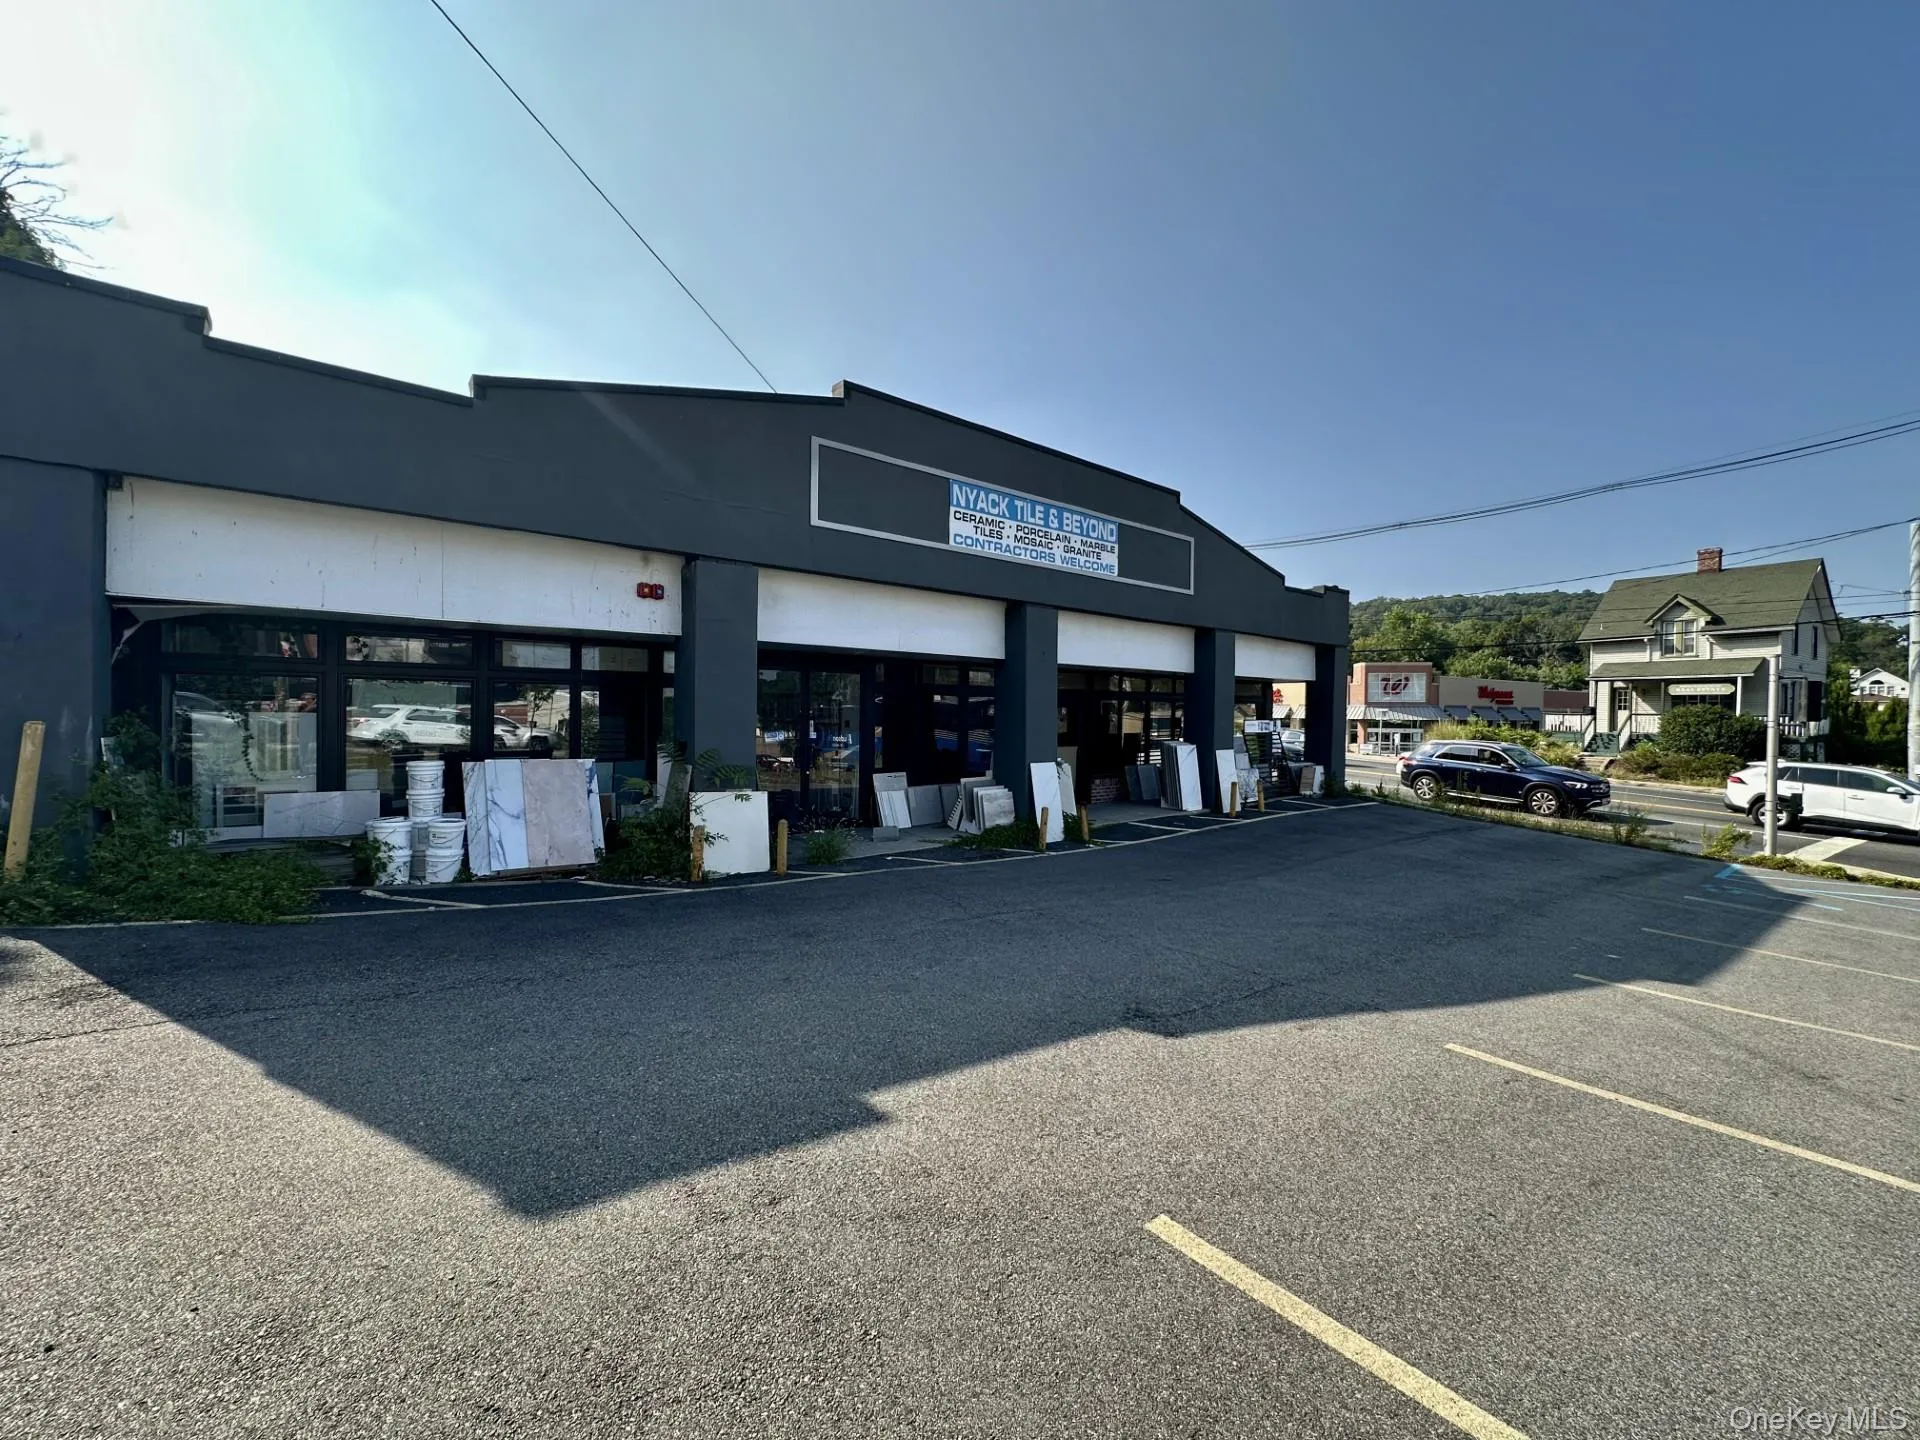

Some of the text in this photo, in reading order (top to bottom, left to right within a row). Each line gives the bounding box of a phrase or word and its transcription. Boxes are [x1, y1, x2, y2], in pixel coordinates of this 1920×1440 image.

[953, 484, 1116, 542] NYACK TILE & BEYOND
[953, 510, 1116, 554] CERAMIC PORCELAIN MARBLE
[953, 533, 1116, 574] CONTRACTORS WELCOME
[973, 525, 1102, 560] TILES MOSAIC GRANITE
